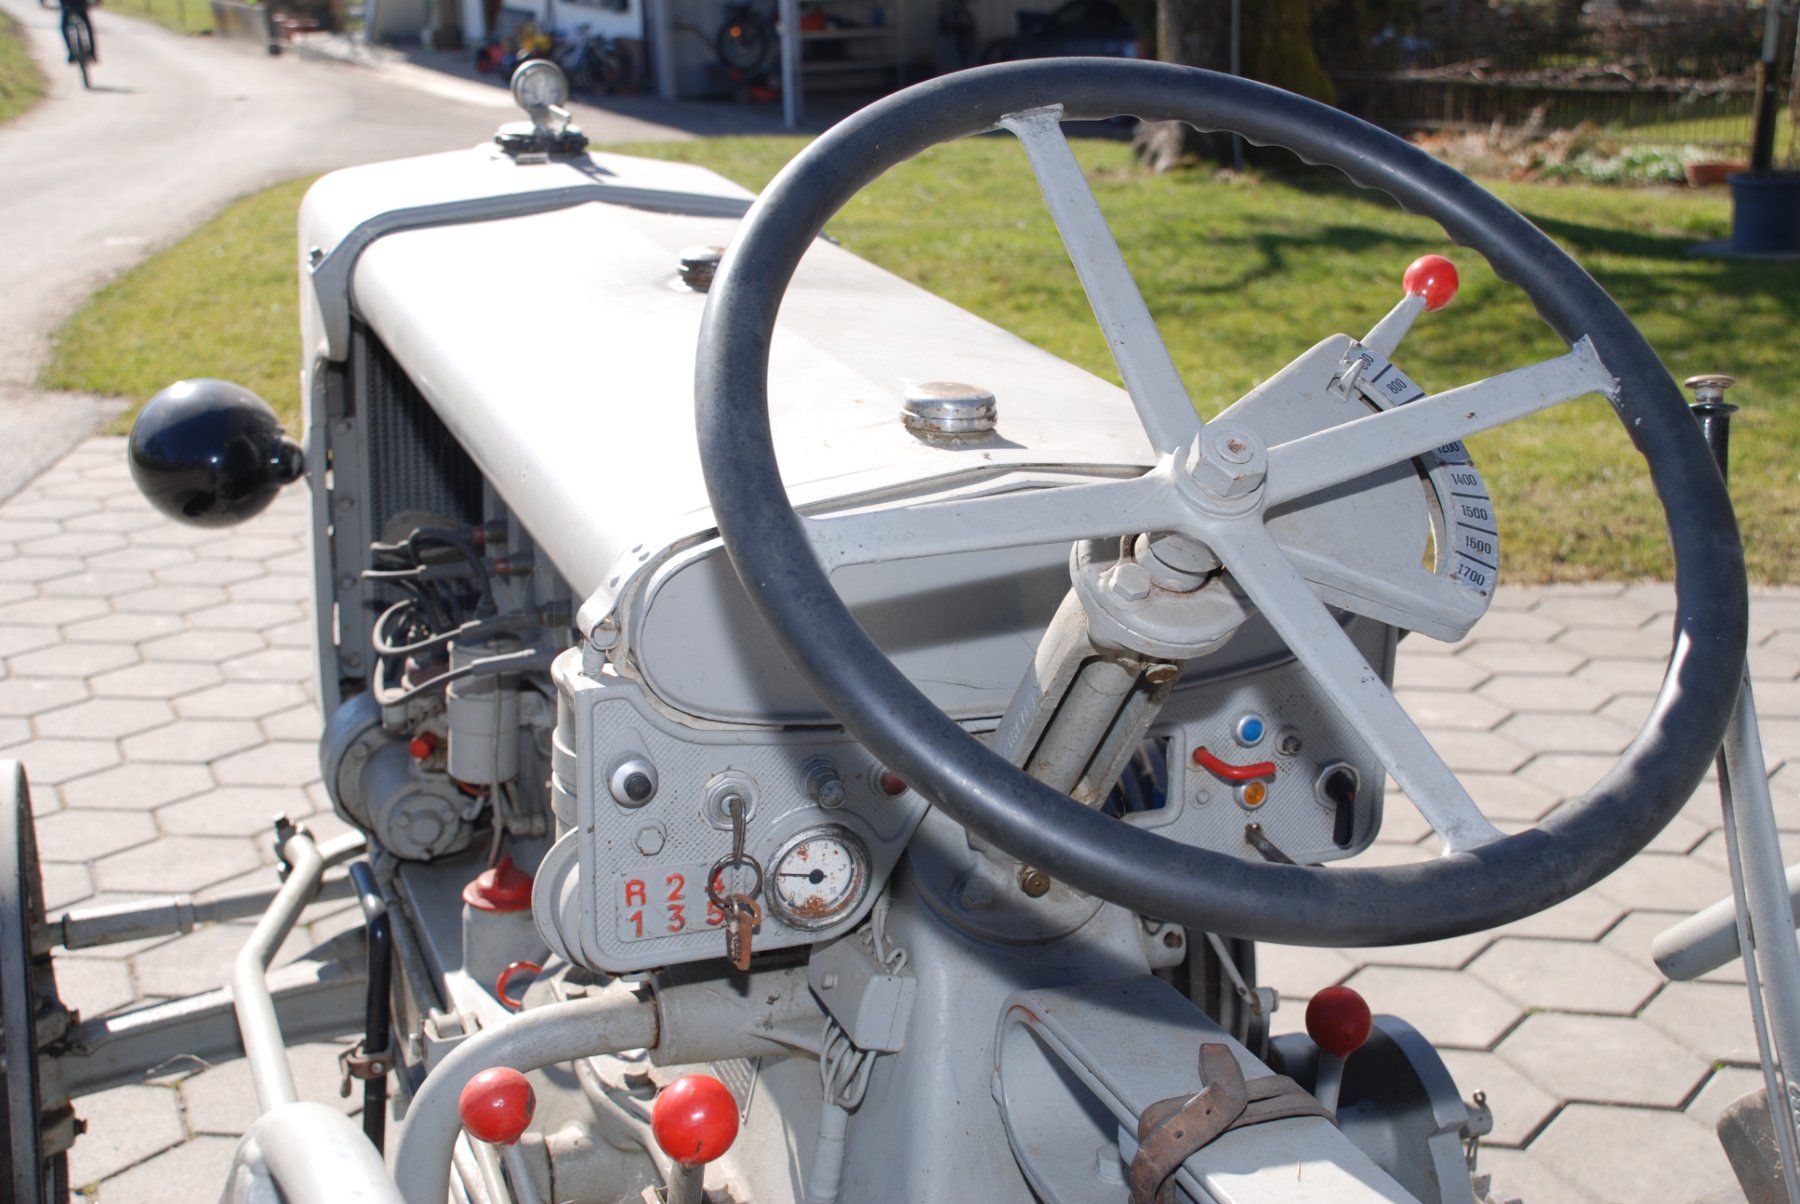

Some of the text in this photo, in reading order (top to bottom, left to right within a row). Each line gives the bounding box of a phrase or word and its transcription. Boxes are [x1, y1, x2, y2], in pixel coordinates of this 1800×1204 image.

[1386, 378, 1407, 394] 800
[1450, 473, 1477, 486] 1400
[1461, 505, 1488, 520] 1500
[1465, 535, 1492, 554] 1600
[1458, 563, 1485, 586] 1700
[625, 879, 646, 907] R
[665, 873, 685, 901] 2
[630, 900, 725, 938] 1 3 5
